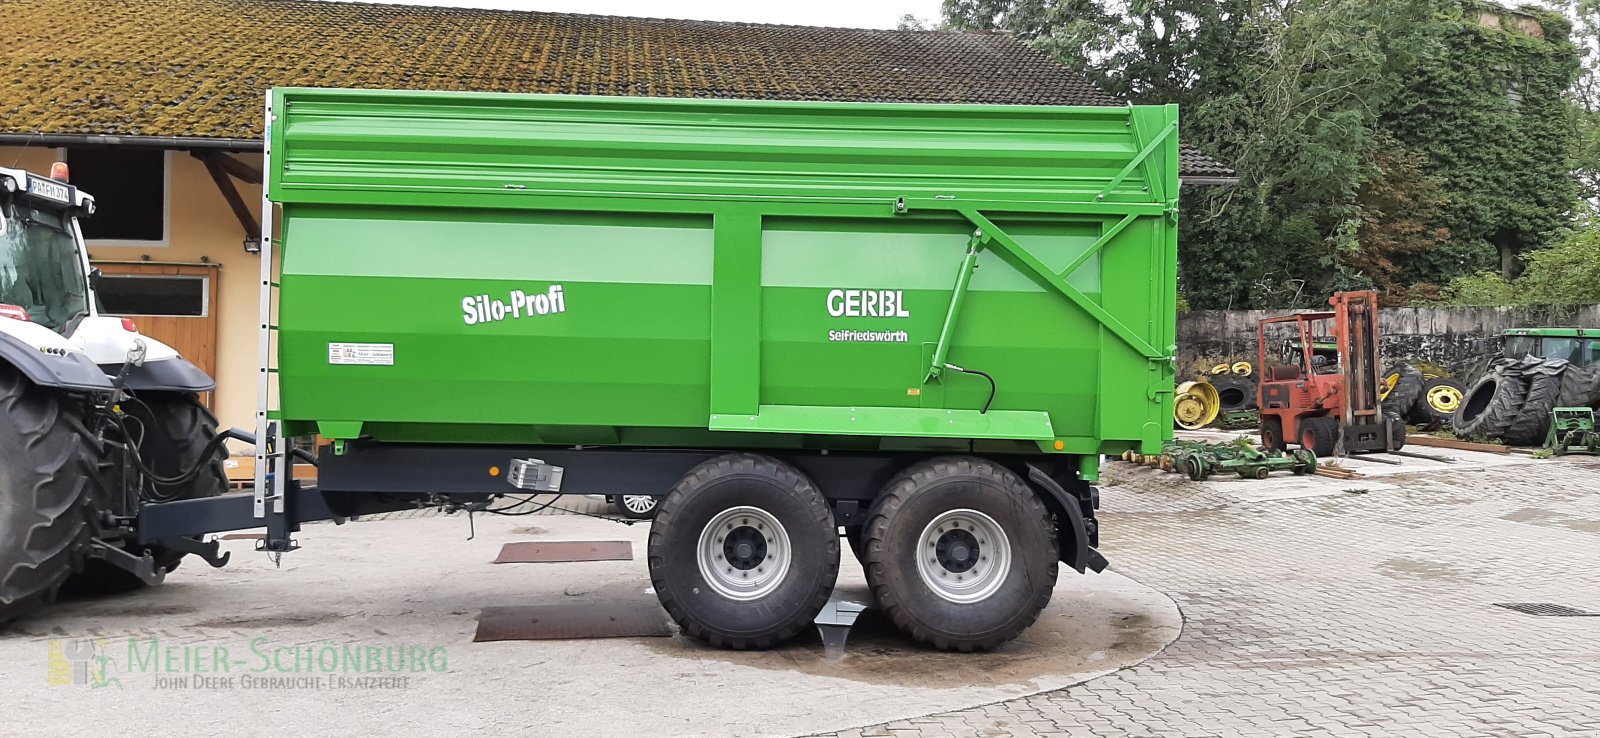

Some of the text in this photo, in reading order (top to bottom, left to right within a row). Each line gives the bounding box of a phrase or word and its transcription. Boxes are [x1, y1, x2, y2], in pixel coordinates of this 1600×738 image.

[462, 284, 566, 325] Silo-Profi
[826, 289, 910, 317] GERBL
[828, 329, 908, 342] Seifriedswörth
